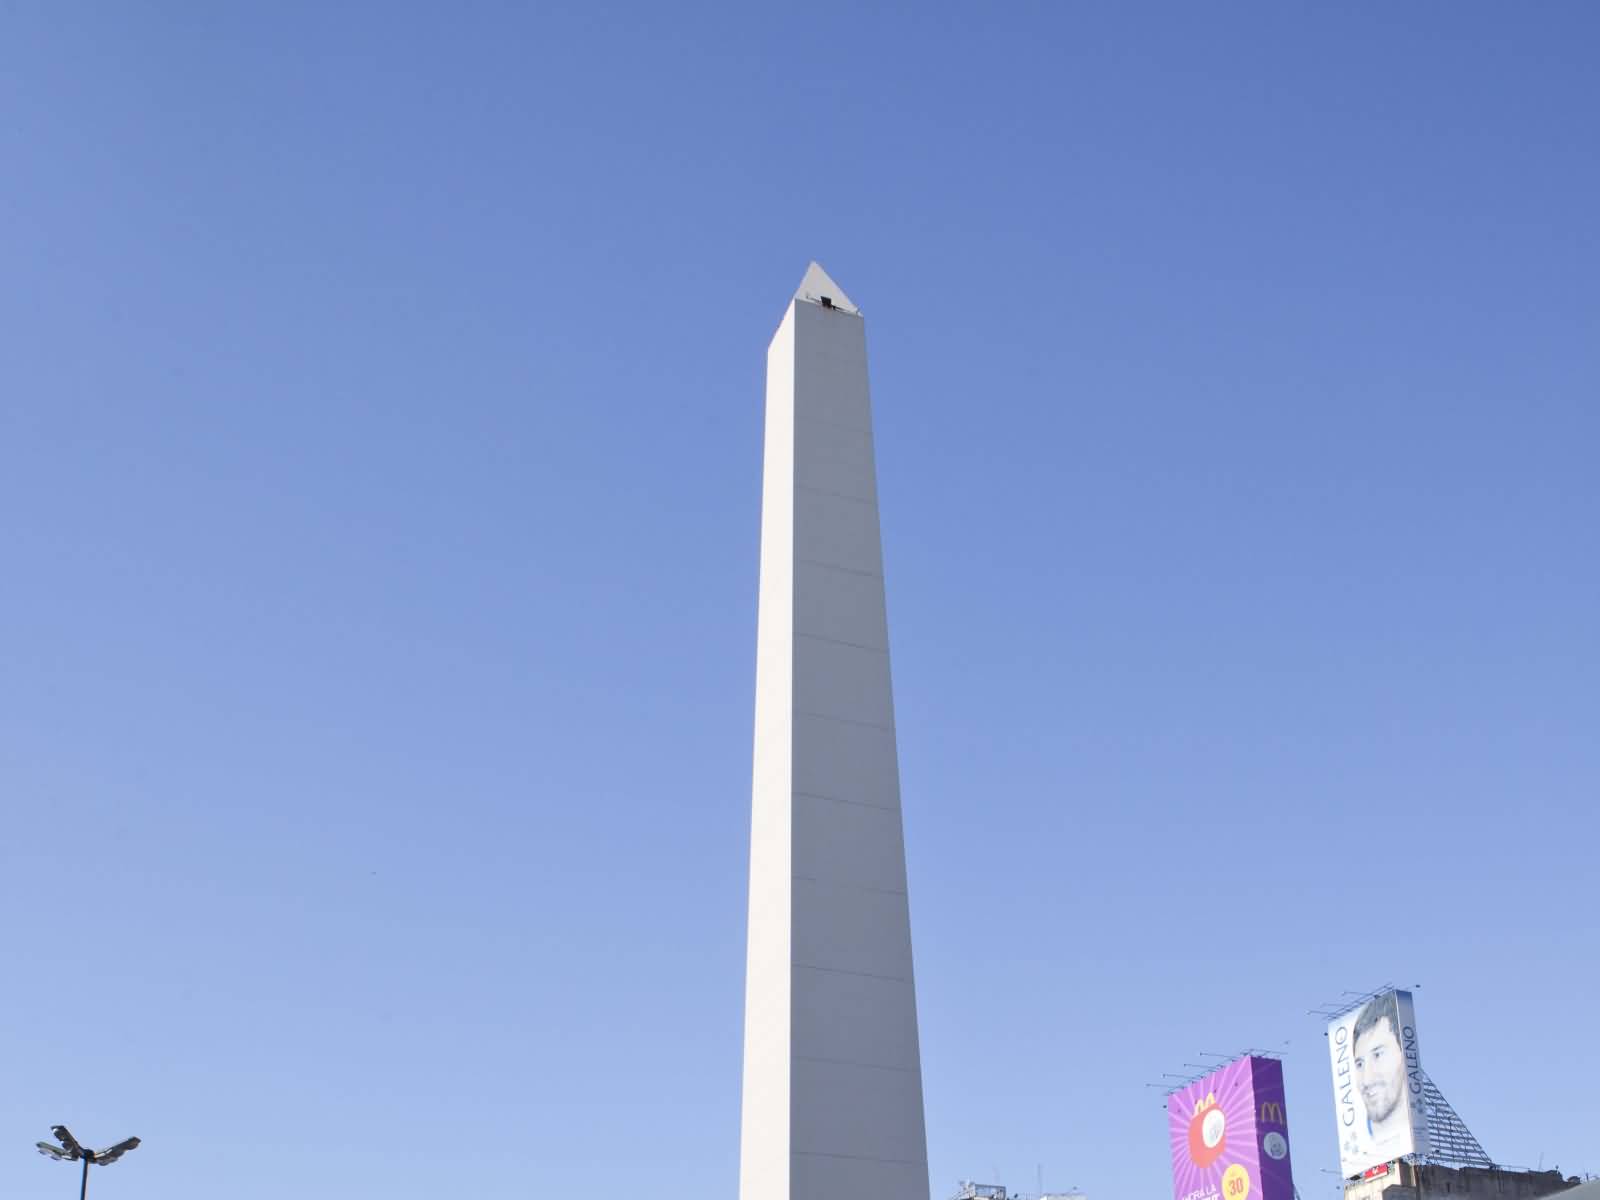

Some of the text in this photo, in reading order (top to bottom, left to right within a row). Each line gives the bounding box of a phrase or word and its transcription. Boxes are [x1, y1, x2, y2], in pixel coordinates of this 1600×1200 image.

[1335, 1026, 1355, 1127] GALENO
[1403, 1026, 1422, 1095] GALENO
[1207, 1183, 1217, 1195] LA
[1229, 1177, 1244, 1196] 30
